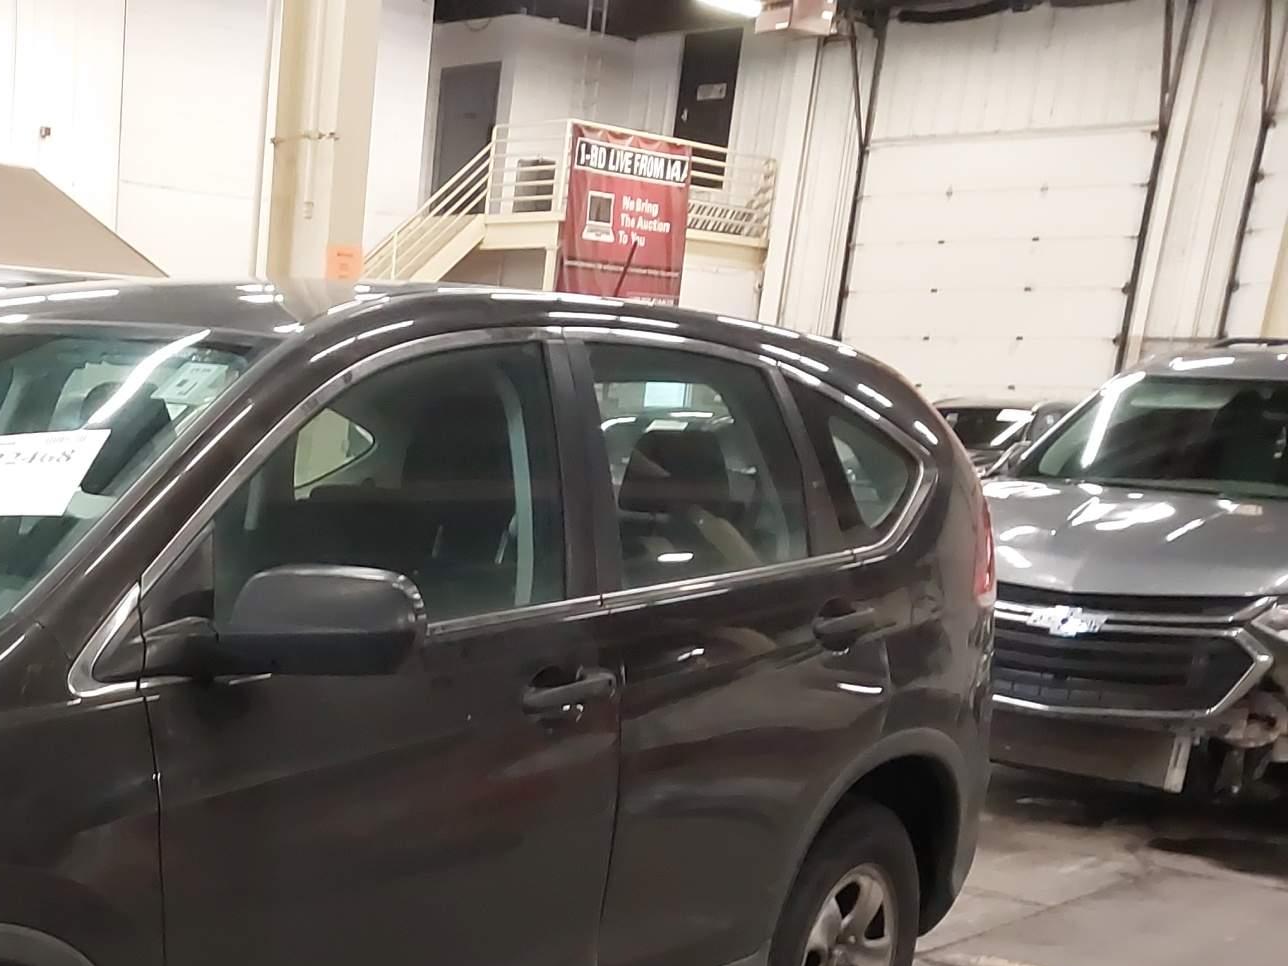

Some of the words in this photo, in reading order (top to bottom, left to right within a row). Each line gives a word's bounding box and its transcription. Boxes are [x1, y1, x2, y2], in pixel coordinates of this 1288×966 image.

[608, 147, 633, 174] LIVE
[633, 152, 665, 180] FROM
[621, 195, 635, 212] We
[635, 198, 660, 218] Bring
[620, 213, 636, 229] The
[636, 215, 671, 234] Auction
[618, 230, 629, 245] To
[630, 231, 646, 248] You
